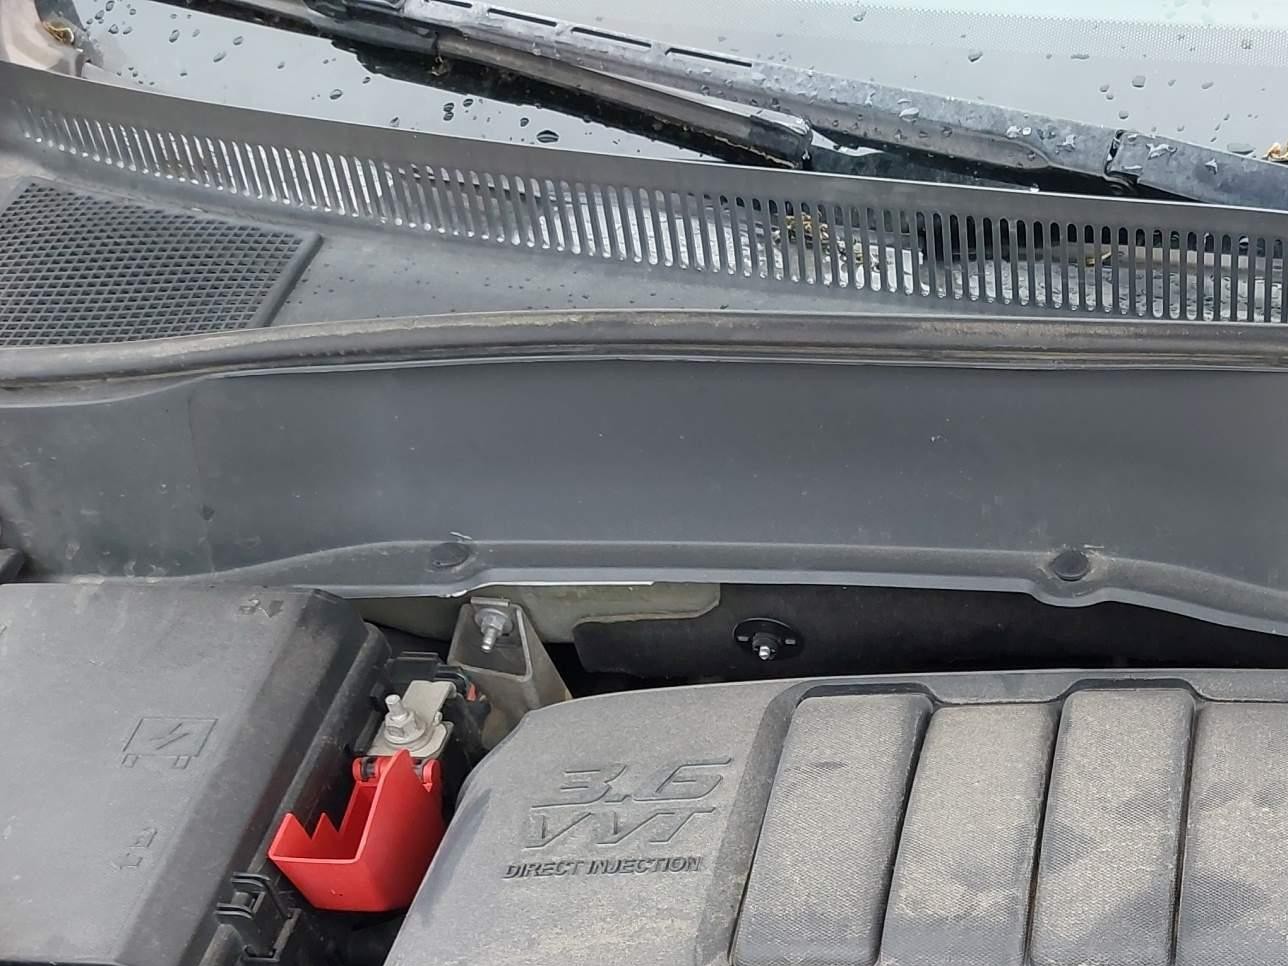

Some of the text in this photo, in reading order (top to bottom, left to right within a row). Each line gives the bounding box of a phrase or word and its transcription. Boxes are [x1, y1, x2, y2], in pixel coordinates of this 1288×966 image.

[531, 757, 732, 808] 3.6
[520, 805, 717, 850] VVT
[502, 855, 705, 880] DIRECT INJECTION
